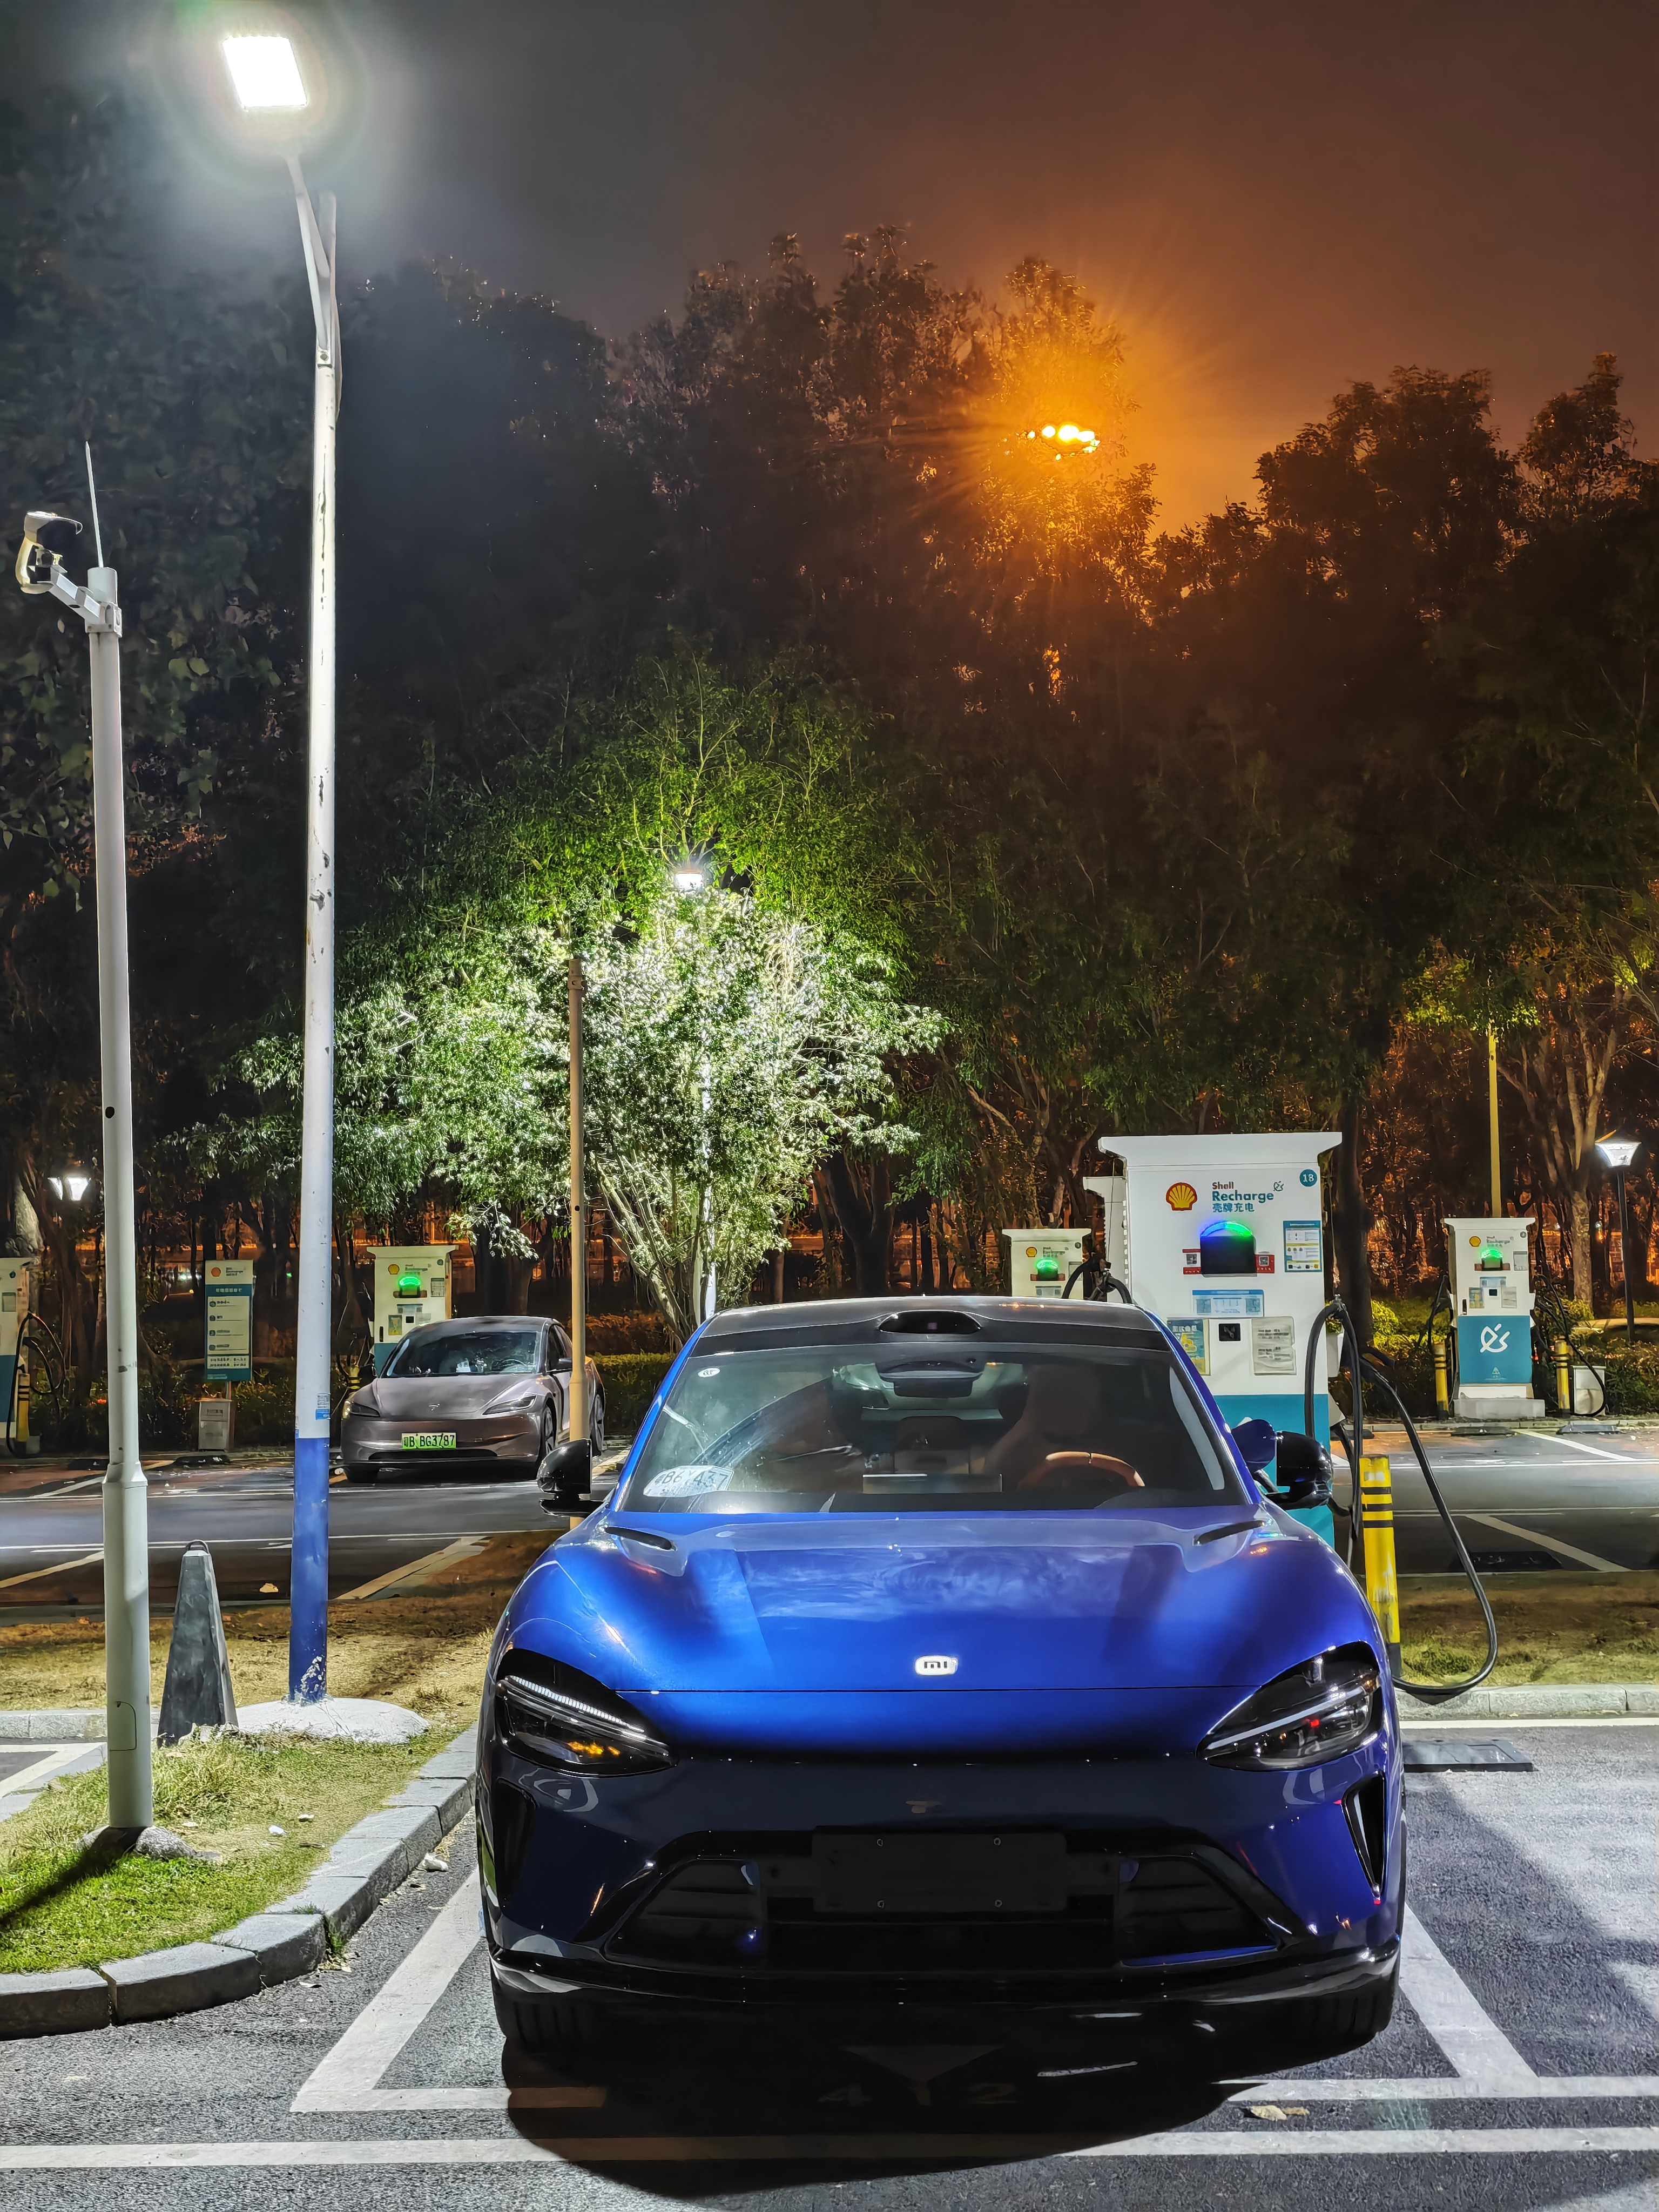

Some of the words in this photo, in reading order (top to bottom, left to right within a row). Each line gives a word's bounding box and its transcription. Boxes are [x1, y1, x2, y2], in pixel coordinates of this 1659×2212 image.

[1303, 1174, 1314, 1183] 18
[1212, 1181, 1234, 1190] Shell
[1212, 1190, 1274, 1203] Recharge
